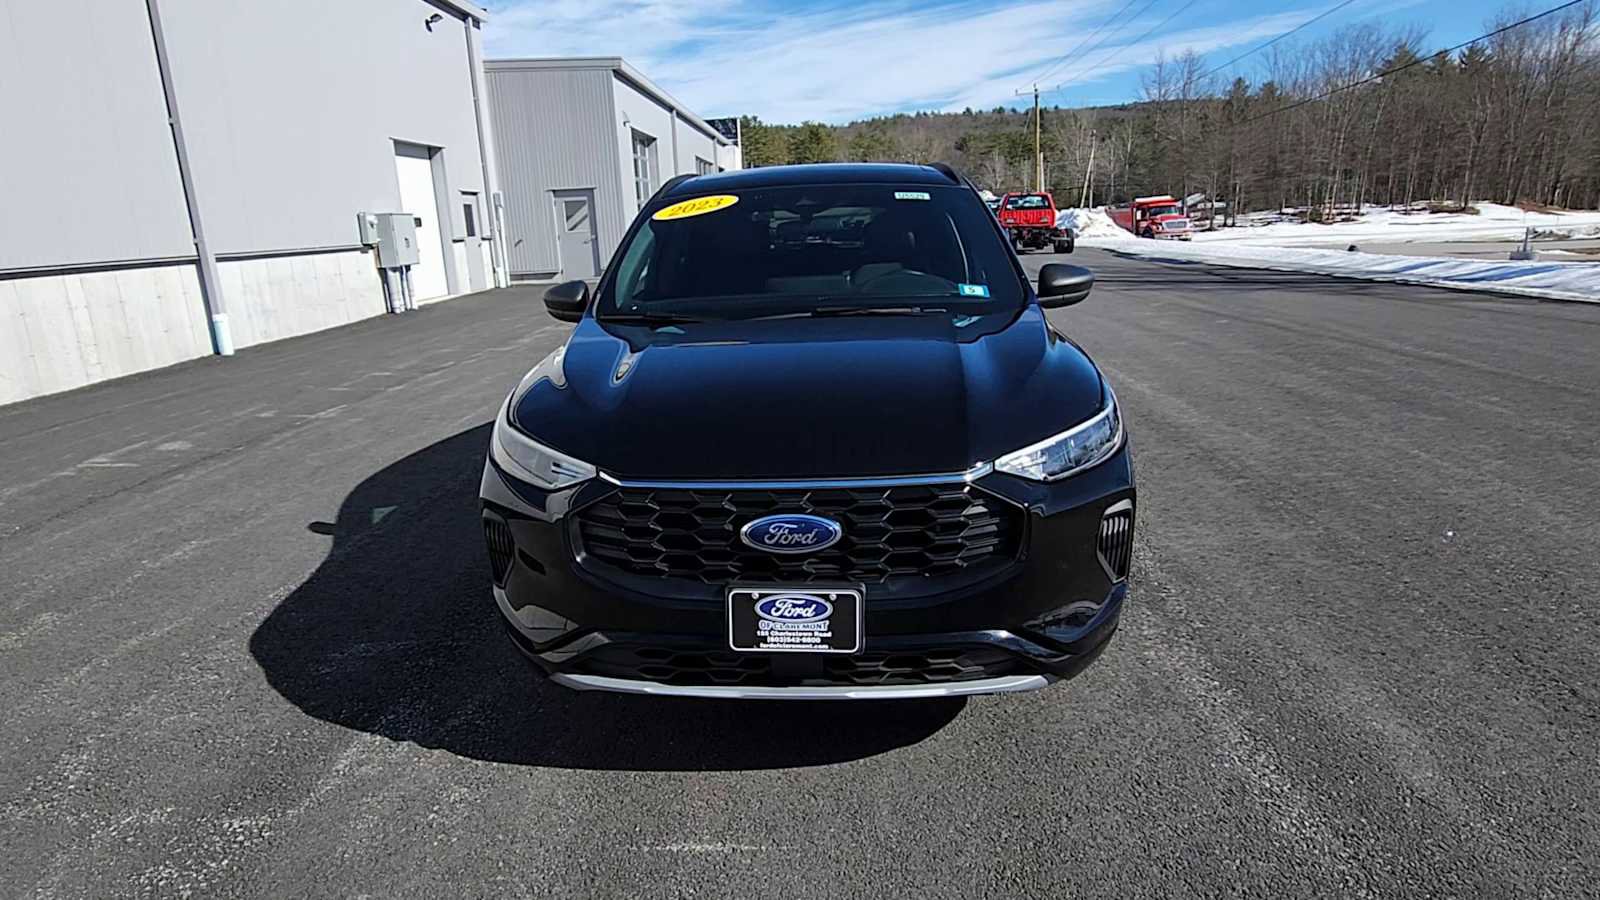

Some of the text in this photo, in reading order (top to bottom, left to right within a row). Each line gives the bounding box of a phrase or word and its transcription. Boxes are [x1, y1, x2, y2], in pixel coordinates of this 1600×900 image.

[667, 198, 724, 216] 2023
[764, 522, 818, 544] Ford
[771, 598, 816, 618] Ford
[759, 620, 829, 631] OF CLAREMONT
